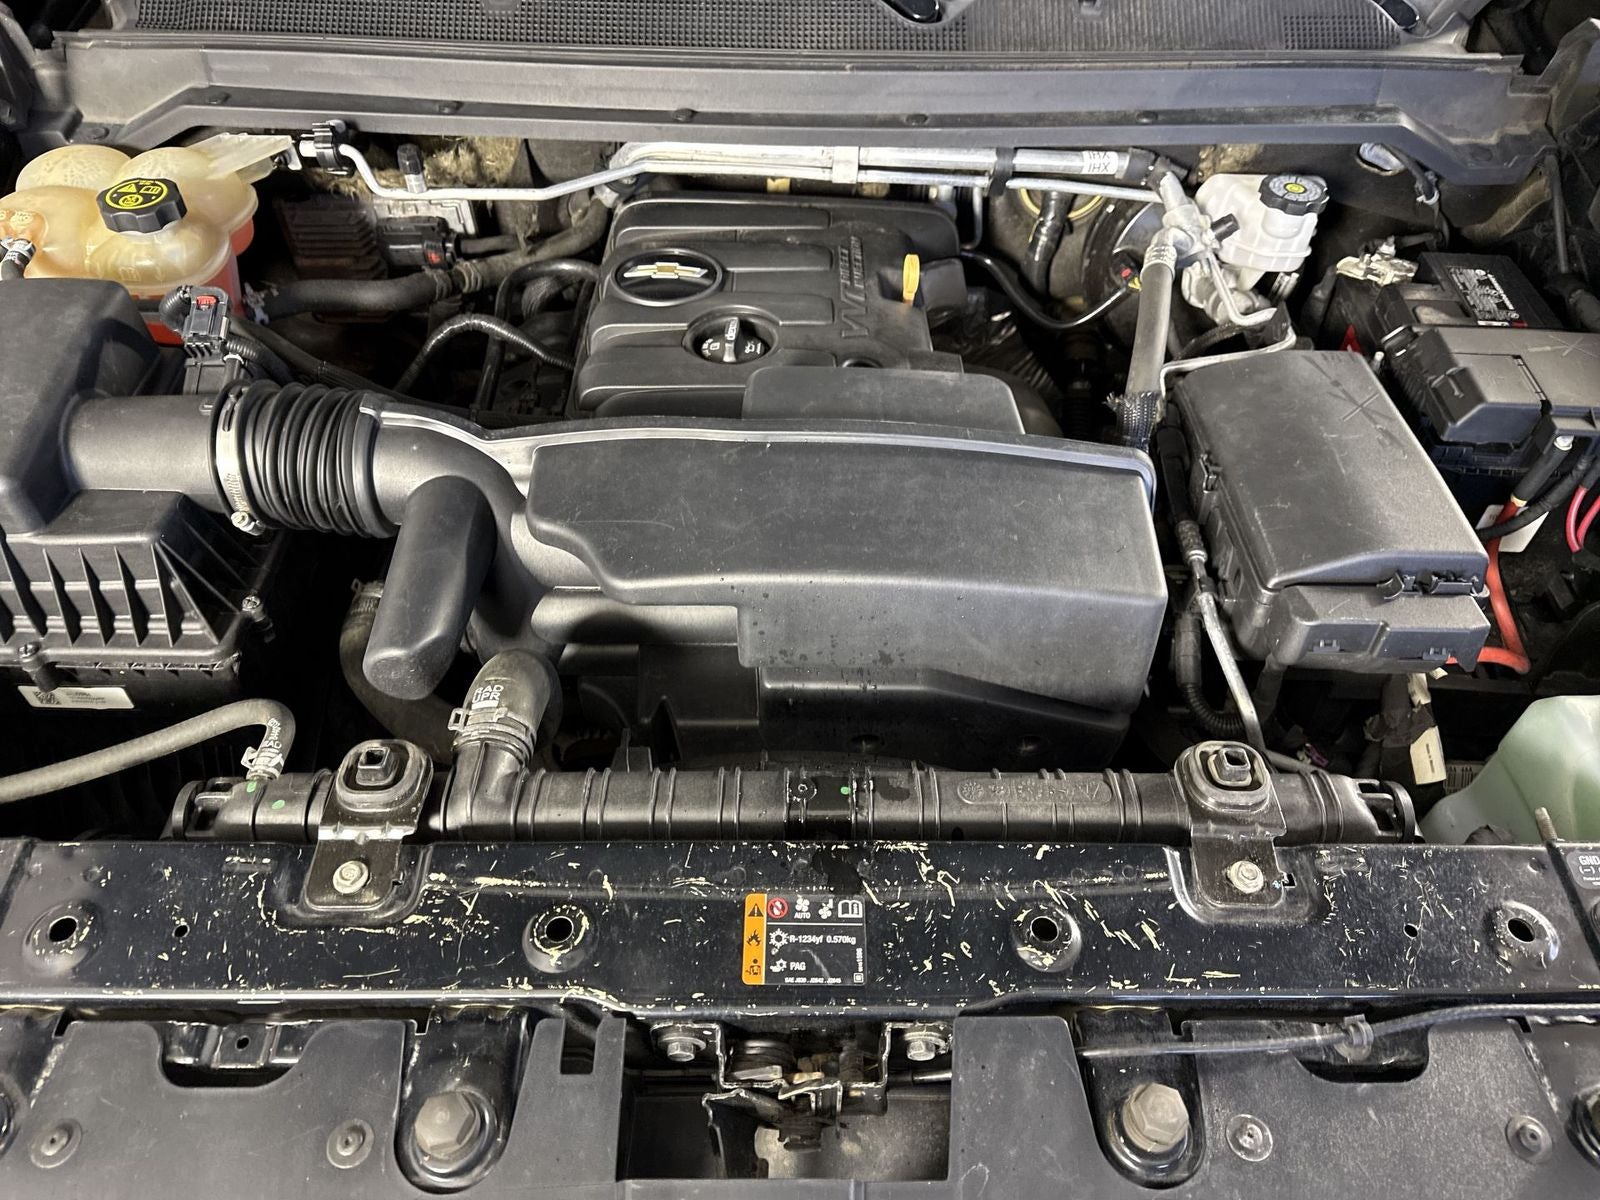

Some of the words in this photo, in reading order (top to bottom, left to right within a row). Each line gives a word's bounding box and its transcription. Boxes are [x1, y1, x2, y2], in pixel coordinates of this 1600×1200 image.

[789, 935, 823, 944] R-1234yf
[826, 935, 856, 945] 0.570kg
[790, 962, 806, 970] PAG
